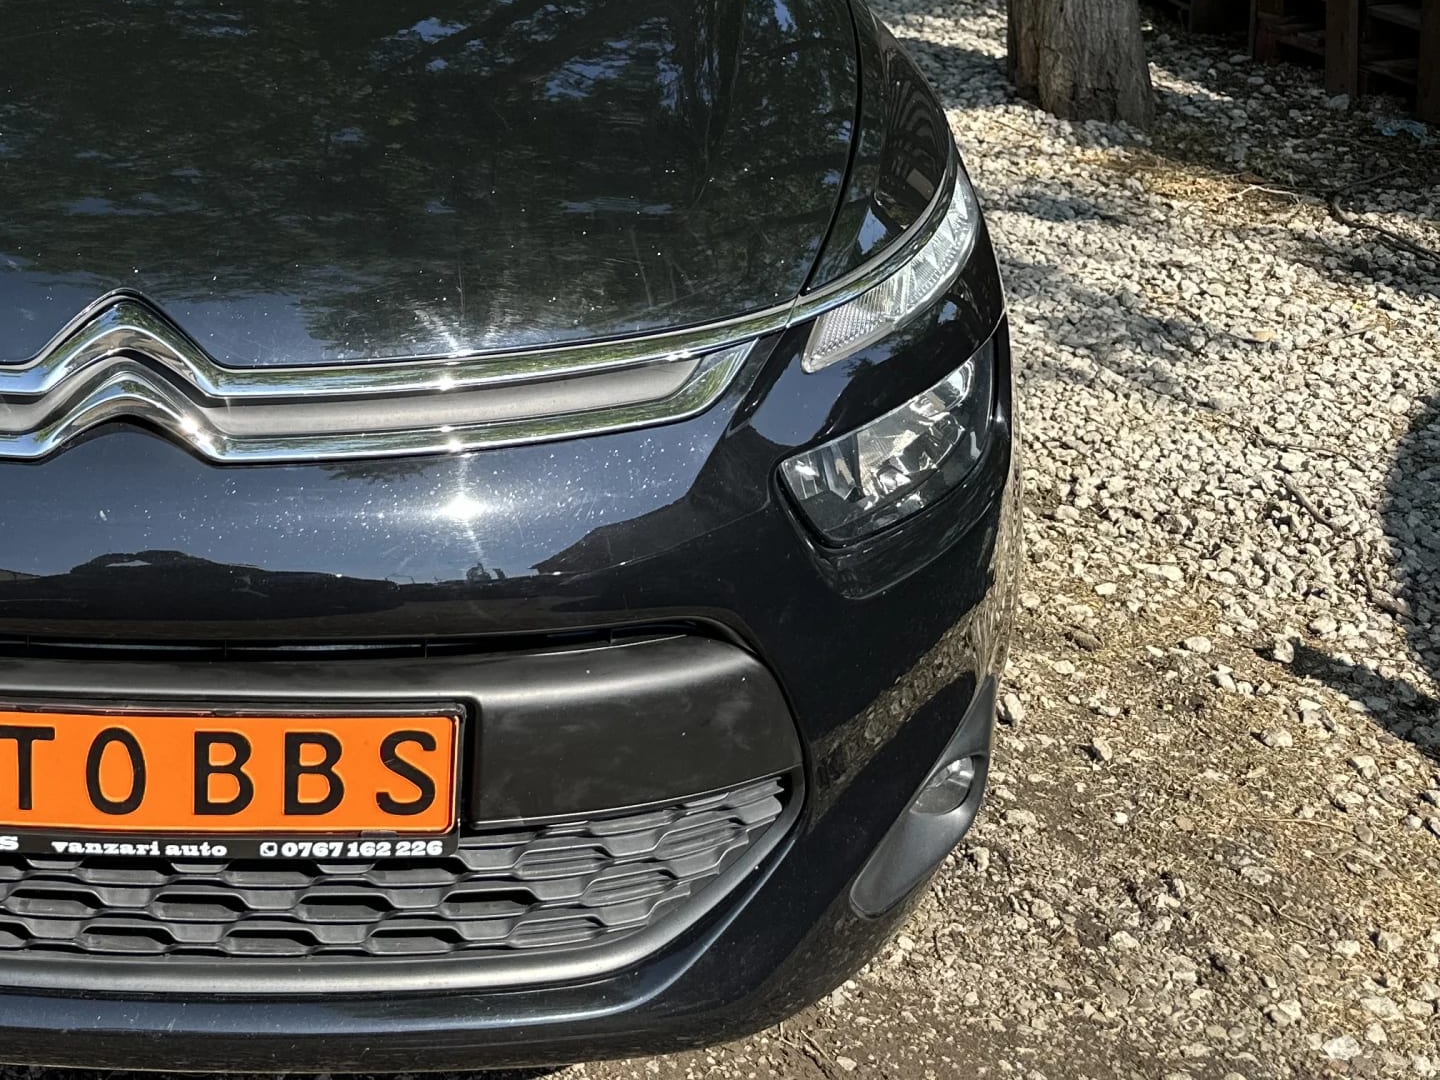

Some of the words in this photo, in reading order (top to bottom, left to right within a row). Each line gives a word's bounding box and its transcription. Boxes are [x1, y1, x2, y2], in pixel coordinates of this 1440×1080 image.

[52, 840, 160, 855] vanzari
[165, 844, 228, 857] auto
[282, 841, 343, 858] 0767
[346, 841, 391, 857] 162
[395, 839, 444, 856] 226
